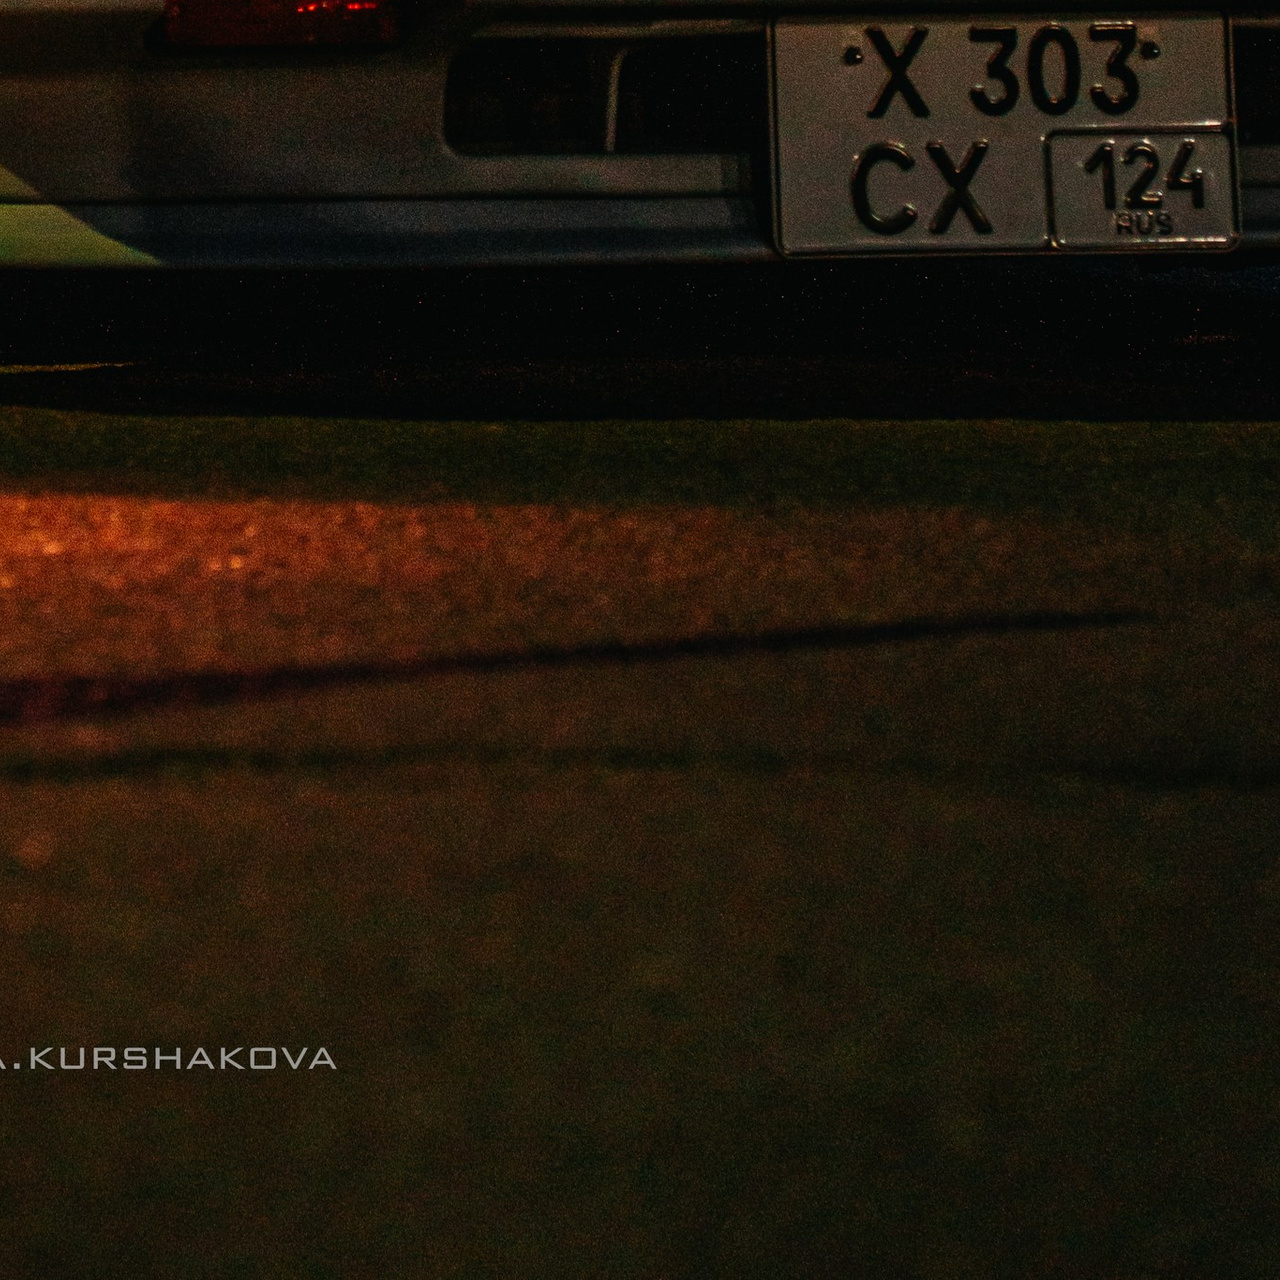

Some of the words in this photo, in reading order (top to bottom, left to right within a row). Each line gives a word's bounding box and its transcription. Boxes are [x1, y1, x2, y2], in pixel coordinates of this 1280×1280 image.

[865, 26, 930, 118] X
[969, 21, 1140, 116] 303
[850, 141, 993, 235] CX
[1083, 139, 1205, 209] 124
[1114, 209, 1172, 235] RUS
